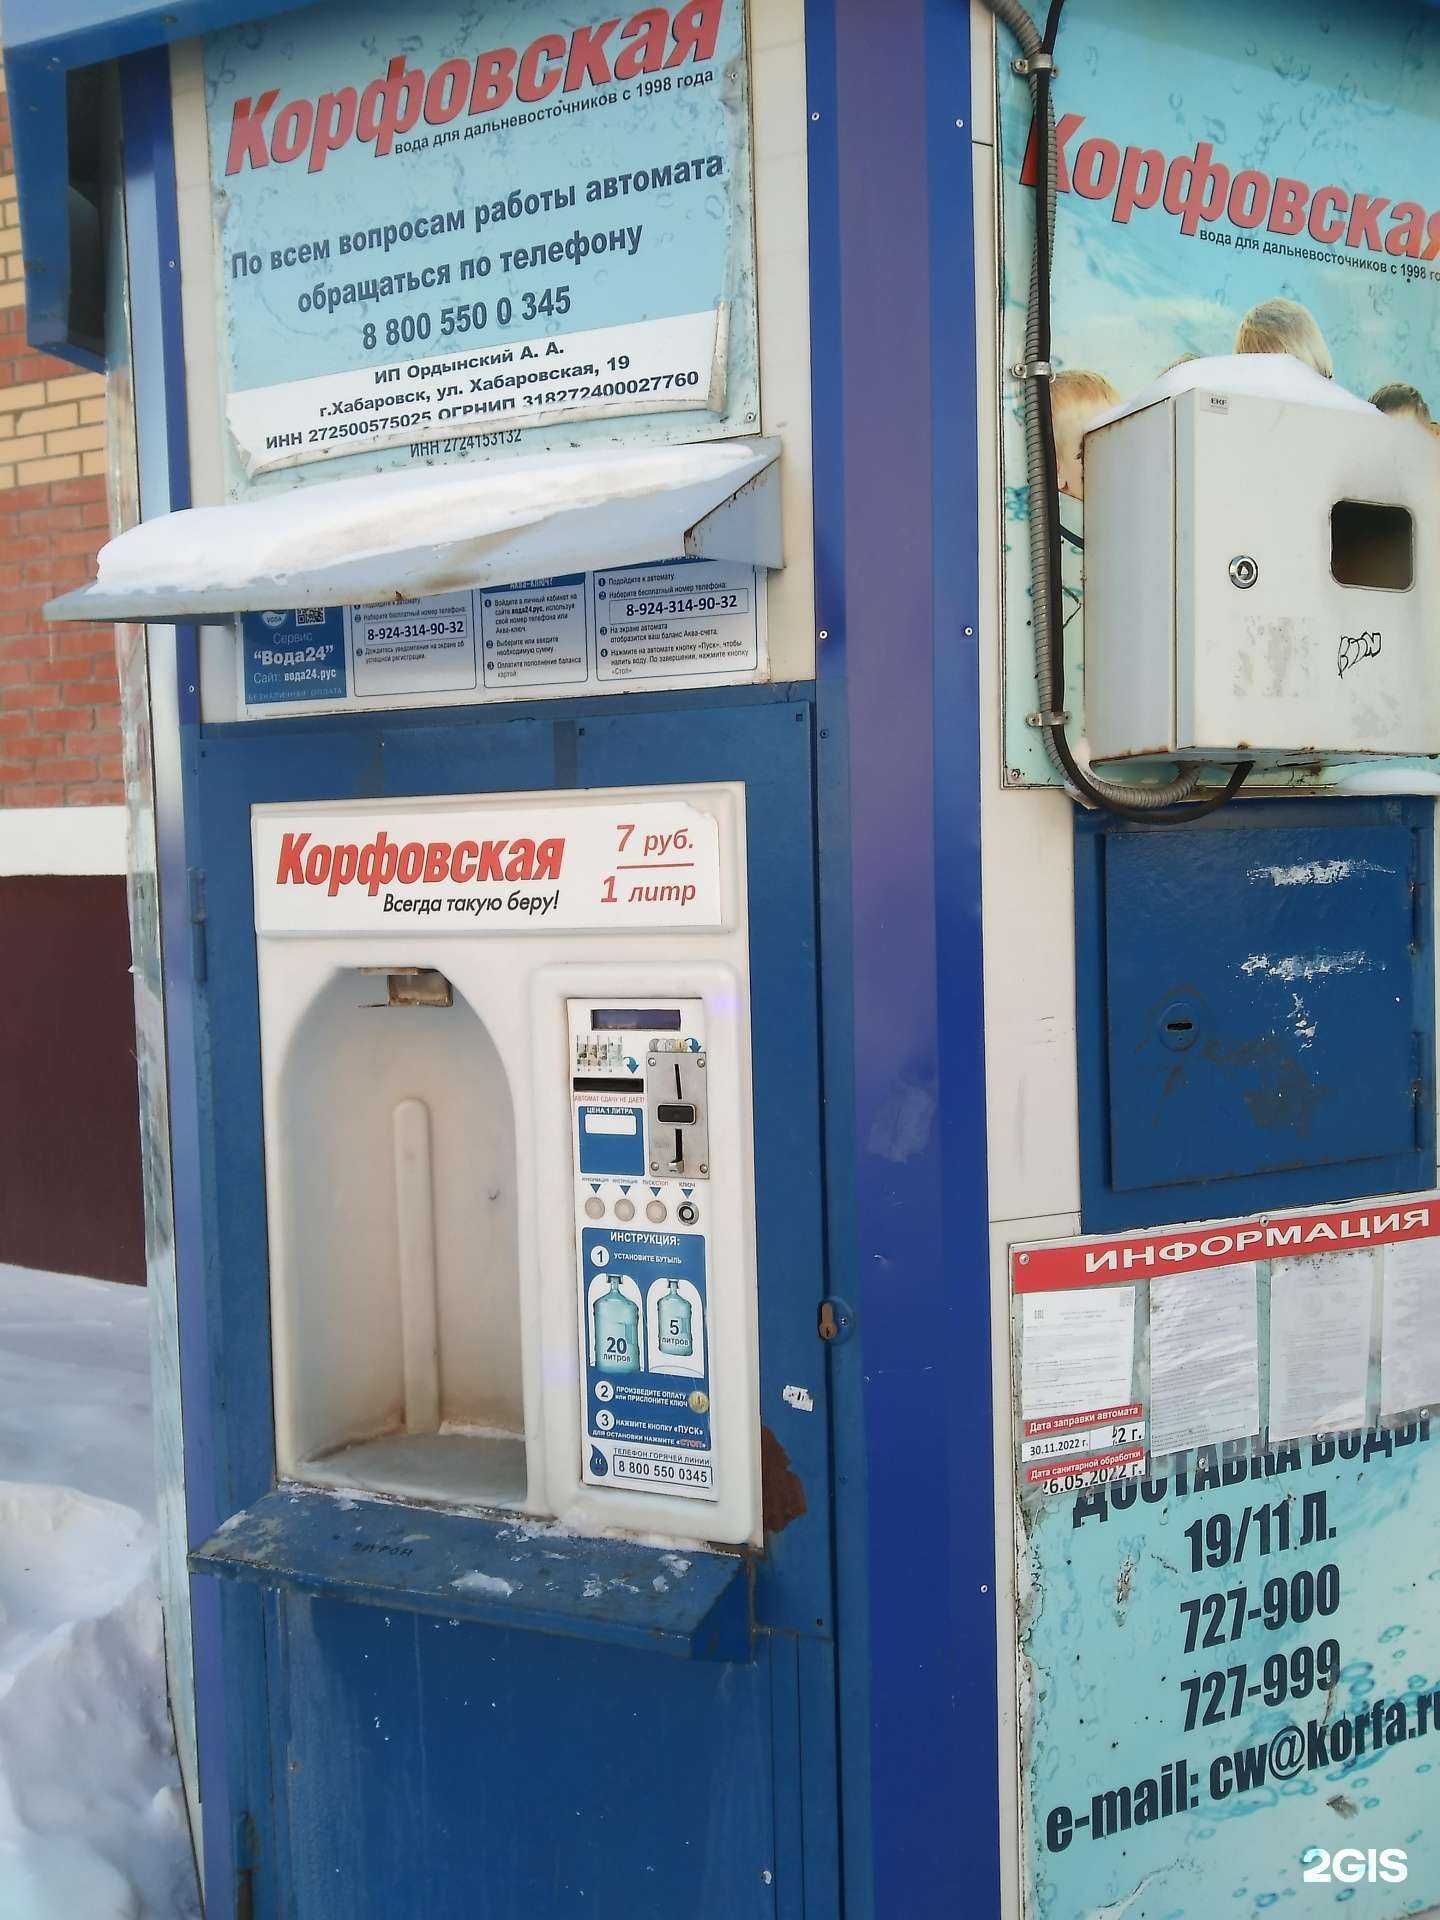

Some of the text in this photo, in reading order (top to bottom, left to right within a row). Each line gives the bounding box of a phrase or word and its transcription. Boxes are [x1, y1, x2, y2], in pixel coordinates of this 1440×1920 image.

[225, 0, 723, 175] Корфовская
[394, 71, 713, 155] вода для дальневосточников с 1998 года
[231, 156, 724, 279] По всем вопросам работы автомата
[298, 222, 643, 314] обращаться по телефону
[1200, 229, 1231, 246] вода
[1235, 236, 1260, 252] для
[1262, 241, 1387, 273] дальневосточников
[1391, 264, 1397, 275] с
[1401, 264, 1426, 280] 1998
[362, 285, 571, 350] 8 800 550 0 345
[375, 341, 564, 384] ИП Ордынский А. А.
[320, 355, 630, 417] г.Хабаровск, ул. Хабаровская, 19
[265, 370, 699, 449] ИНН 272500575025 ОГРНИП 318272400027760
[410, 428, 522, 457] ИНН 2724153132
[626, 595, 737, 616] 8-924-314-90-32
[273, 632, 313, 646] Сервис
[368, 621, 464, 641] 8-924-314-90-32
[284, 668, 337, 682] вода24.рус
[616, 824, 695, 857] 7 руб.
[276, 831, 566, 897] Корфовская
[383, 890, 559, 916] Всегда такую беру!
[600, 876, 697, 907] 1 литр
[611, 1231, 680, 1246] ИНСТРУКЦИЯ:
[1085, 1208, 1430, 1274] ИНФОРМАЦИЯ
[597, 1250, 682, 1264] 1 УСТАНОВИТЕ БУТЫЛЬ
[670, 1320, 679, 1335] 5
[607, 1336, 627, 1354] 20
[600, 1385, 687, 1400] 2 ПРОИЗВЕДИТЕ ОПЛАТУ
[627, 1394, 669, 1406] ПРИСЛОНИТЕ
[670, 1400, 688, 1408] КЛЮЧ
[601, 1413, 609, 1427] 3
[616, 1419, 647, 1429] НАЖМИТЕ
[647, 1423, 673, 1432] КНОПКУ
[1029, 1406, 1138, 1433] Дата заправки автомата
[607, 1431, 643, 1441] ОСТАНОВКИ
[644, 1435, 675, 1445] НАЖМИТЕ
[1030, 1438, 1080, 1456] 30.11.2022
[1082, 1438, 1089, 1448] г.
[614, 1447, 648, 1458] ТЕЛЕФОН
[649, 1452, 683, 1462] ГОРЯЧЕЙ
[1031, 1451, 1141, 1481] Дата санитарной обработки
[618, 1460, 708, 1483] 8 800 550 0345
[1184, 1490, 1337, 1573] 19/11 Л.
[1180, 1563, 1340, 1654] 727-900
[1180, 1639, 1340, 1733] 727-999
[1046, 1759, 1199, 1853] e-mail:
